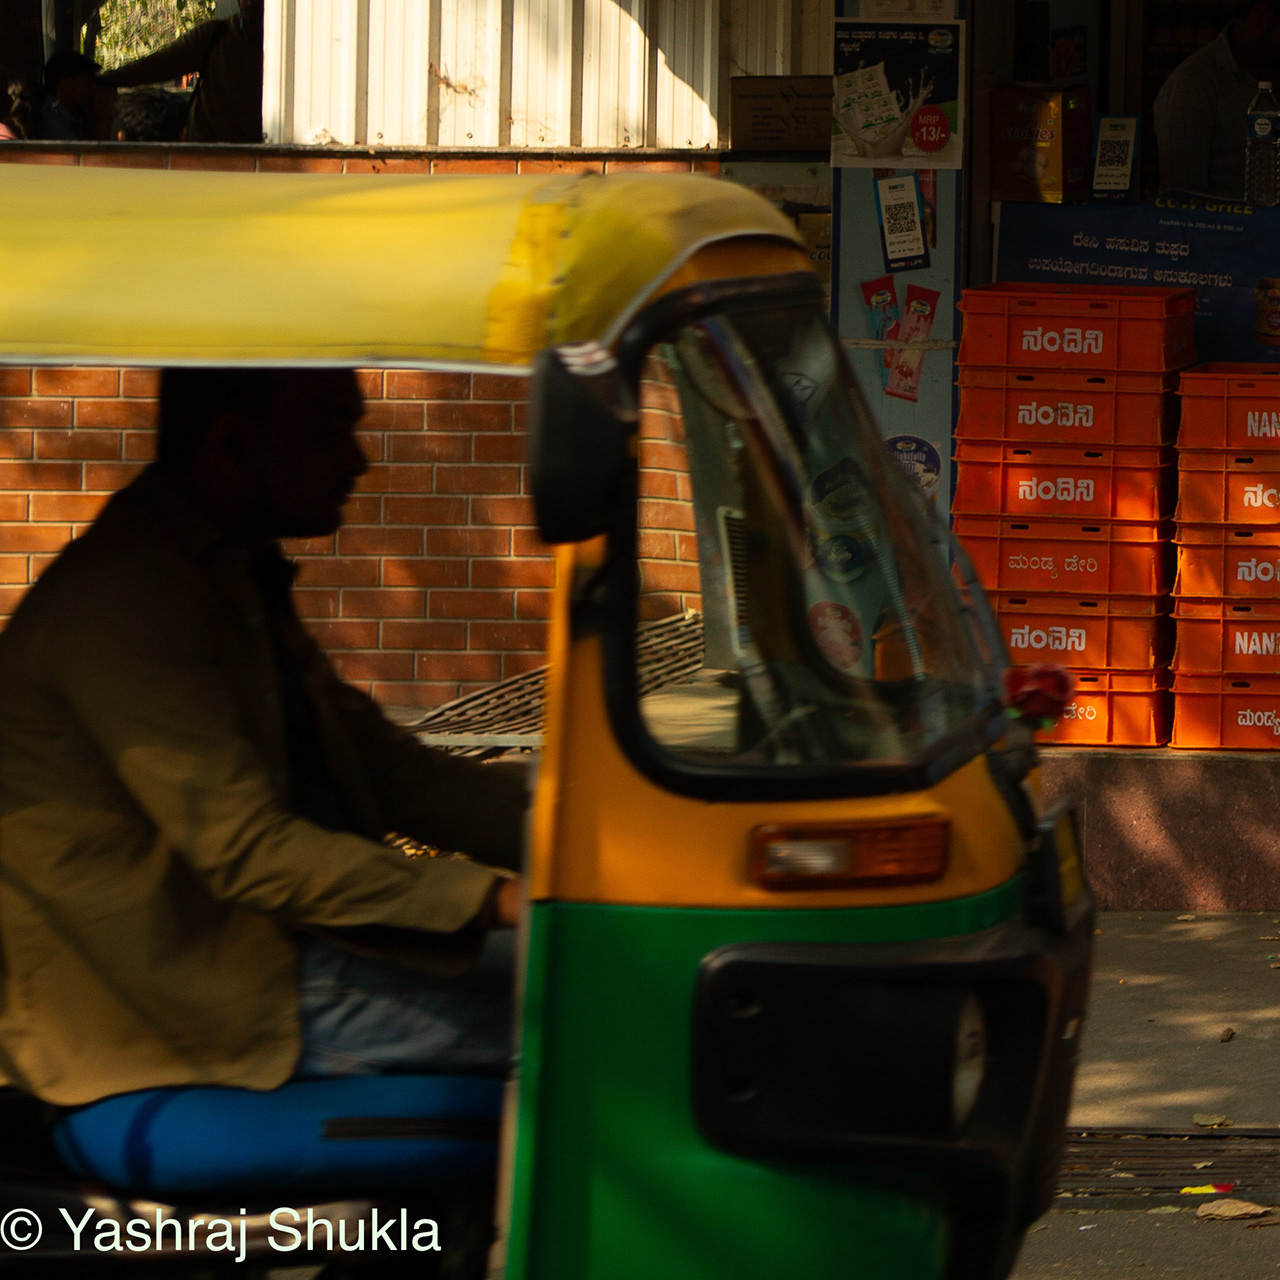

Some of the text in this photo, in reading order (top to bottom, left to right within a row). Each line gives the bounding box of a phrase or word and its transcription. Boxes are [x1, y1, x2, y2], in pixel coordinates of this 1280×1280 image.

[919, 115, 940, 124] MRP
[1002, 125, 1057, 141] cookies
[1104, 235, 1150, 253] ಹಸುವಿನ
[1155, 240, 1191, 261] ತುಪ್ಪದ
[1027, 256, 1234, 288] ಉಪಯೋಗದಿಂದಾಗುವ ಅನುಕೂಲಗಳು
[1021, 326, 1105, 355] ನಂದಿನಿ
[1017, 400, 1095, 428] ನಂದಿನಿ
[1018, 476, 1095, 503] ನಂದಿನಿ
[1063, 554, 1098, 574] ಡೇರಿ
